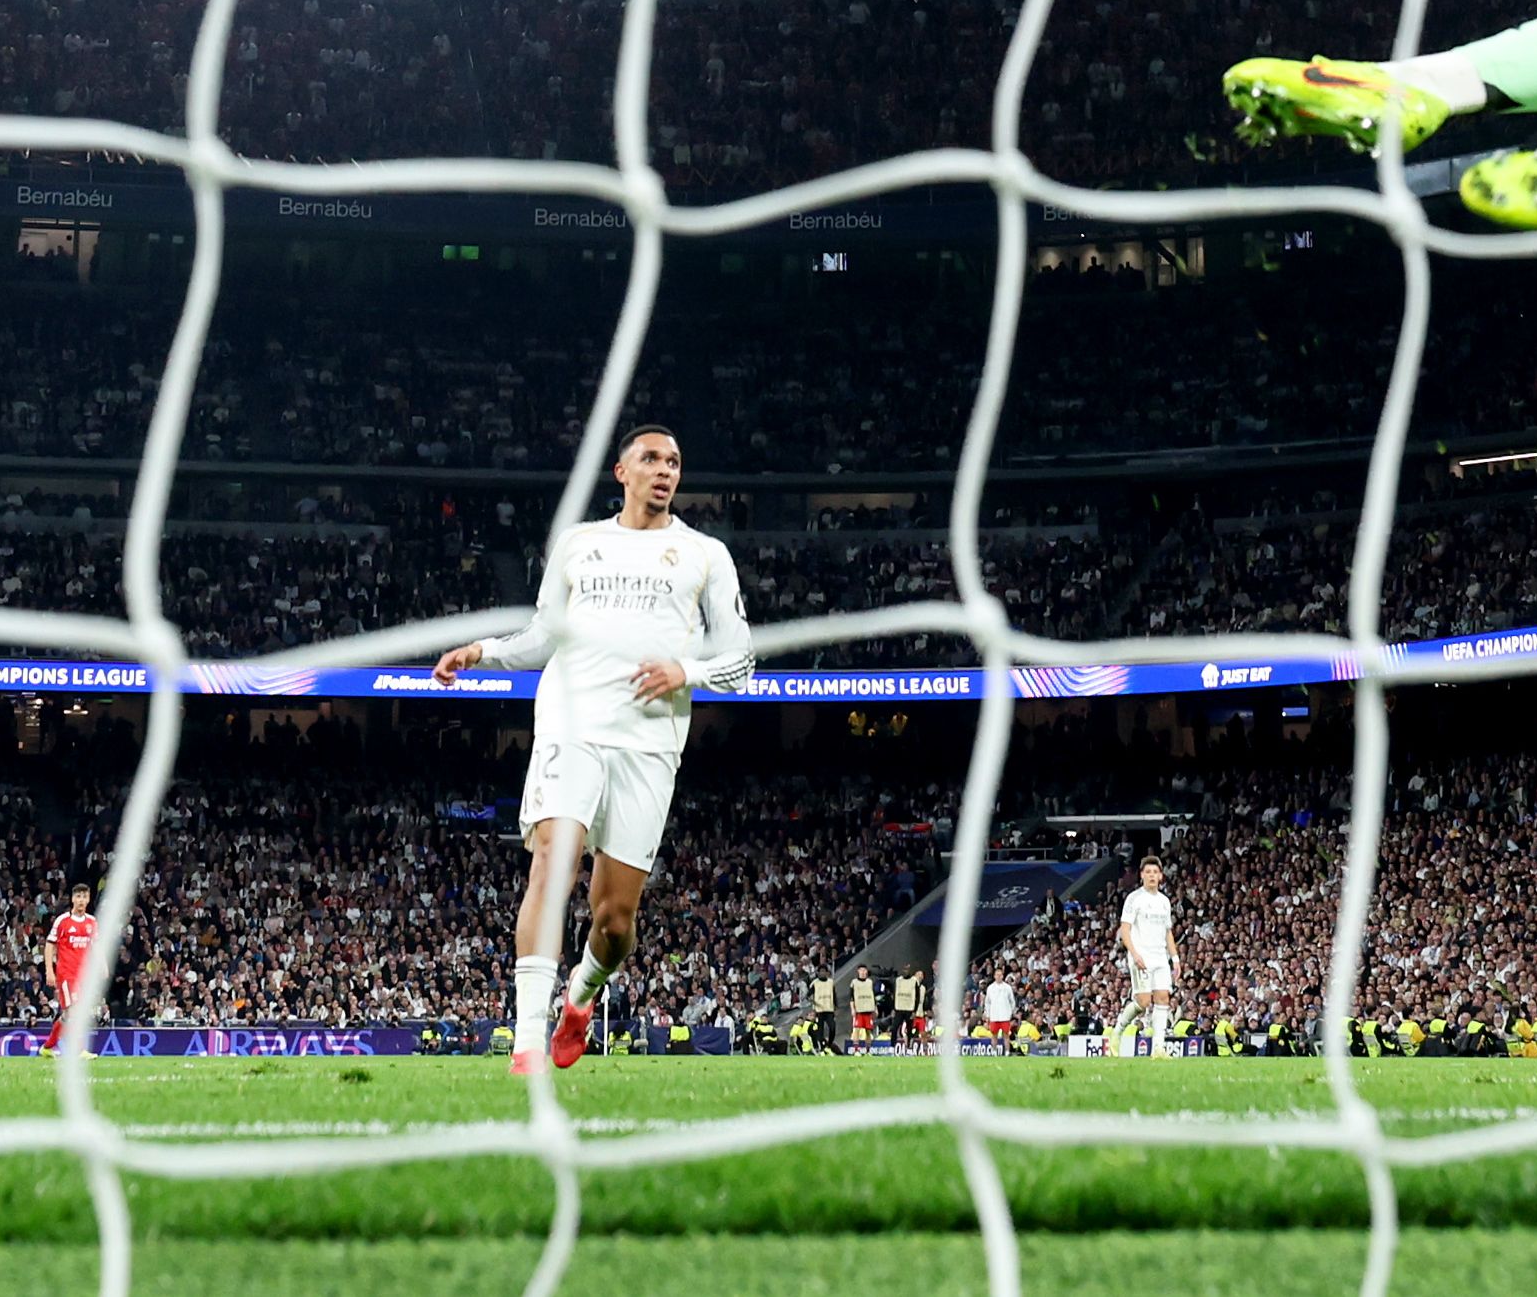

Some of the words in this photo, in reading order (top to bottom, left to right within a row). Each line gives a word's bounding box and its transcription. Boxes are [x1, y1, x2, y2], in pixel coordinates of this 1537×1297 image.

[17, 187, 112, 208] Bernabéu
[279, 197, 372, 219] Bernabéu
[534, 208, 627, 229] Bernabéu
[789, 212, 882, 230] Bernabéu
[580, 573, 674, 596] Emirates
[613, 594, 658, 611] BETTER
[1443, 640, 1474, 662] UEFA
[72, 668, 147, 687] LEAGUE
[784, 677, 896, 695] CHAMPIONS
[899, 676, 970, 695] LEAGUE
[1221, 668, 1250, 686] JUST
[1249, 666, 1273, 683] EAT
[534, 744, 561, 780] 12
